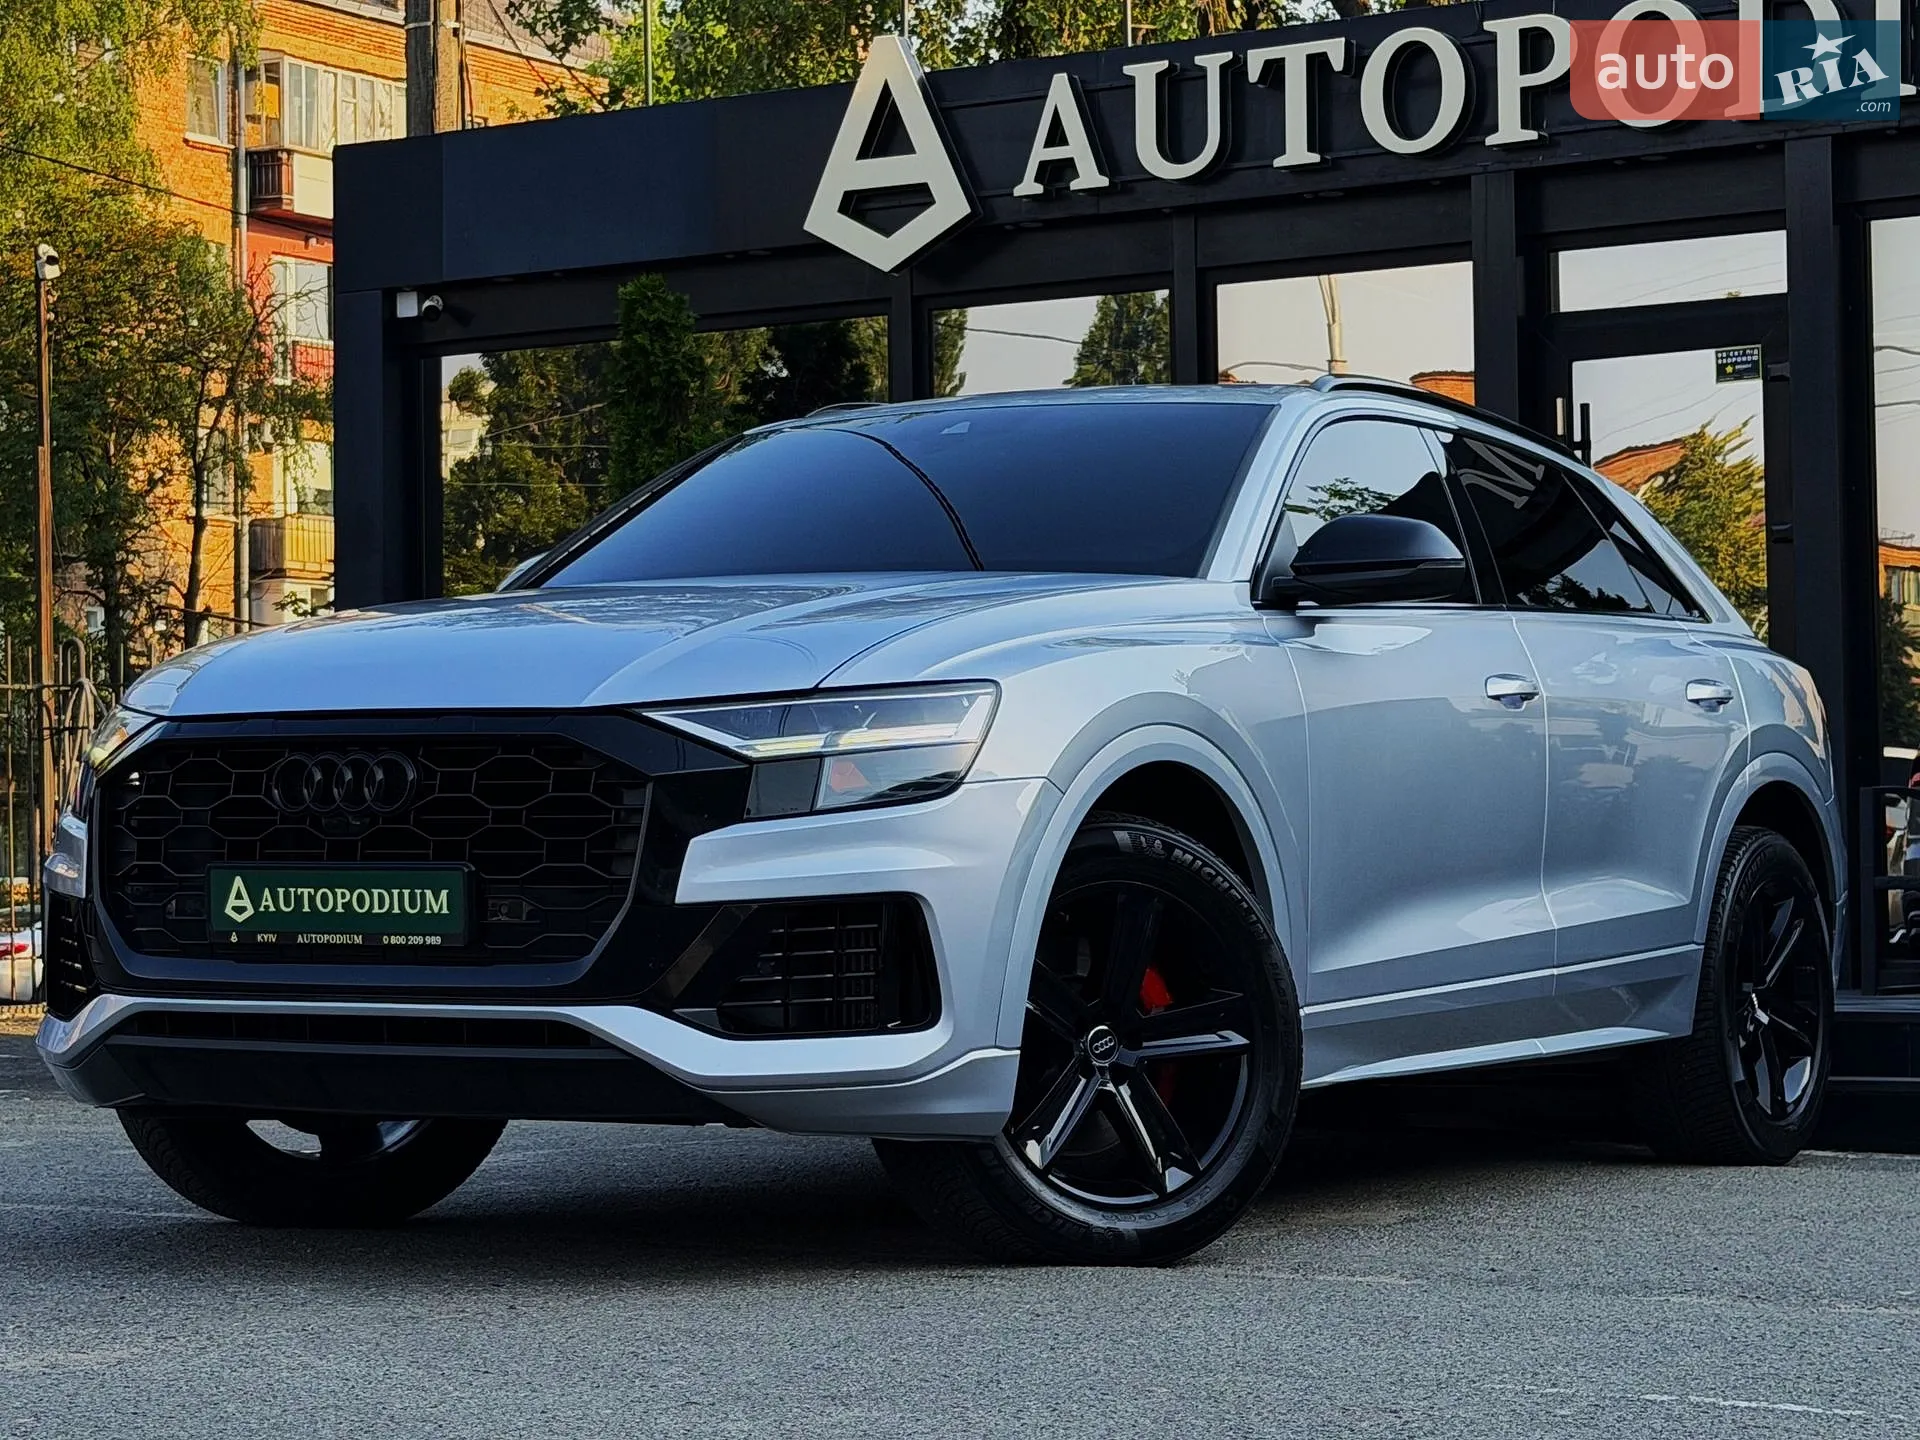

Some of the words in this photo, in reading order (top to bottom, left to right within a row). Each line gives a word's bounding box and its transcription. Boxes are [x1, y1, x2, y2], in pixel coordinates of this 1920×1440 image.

[258, 887, 450, 914] AUTOPODIUM
[257, 933, 277, 943] KYIV
[296, 933, 363, 945] AUTOPODIUM
[390, 936, 406, 945] 800
[407, 936, 424, 945] 209
[425, 937, 442, 945] 989
